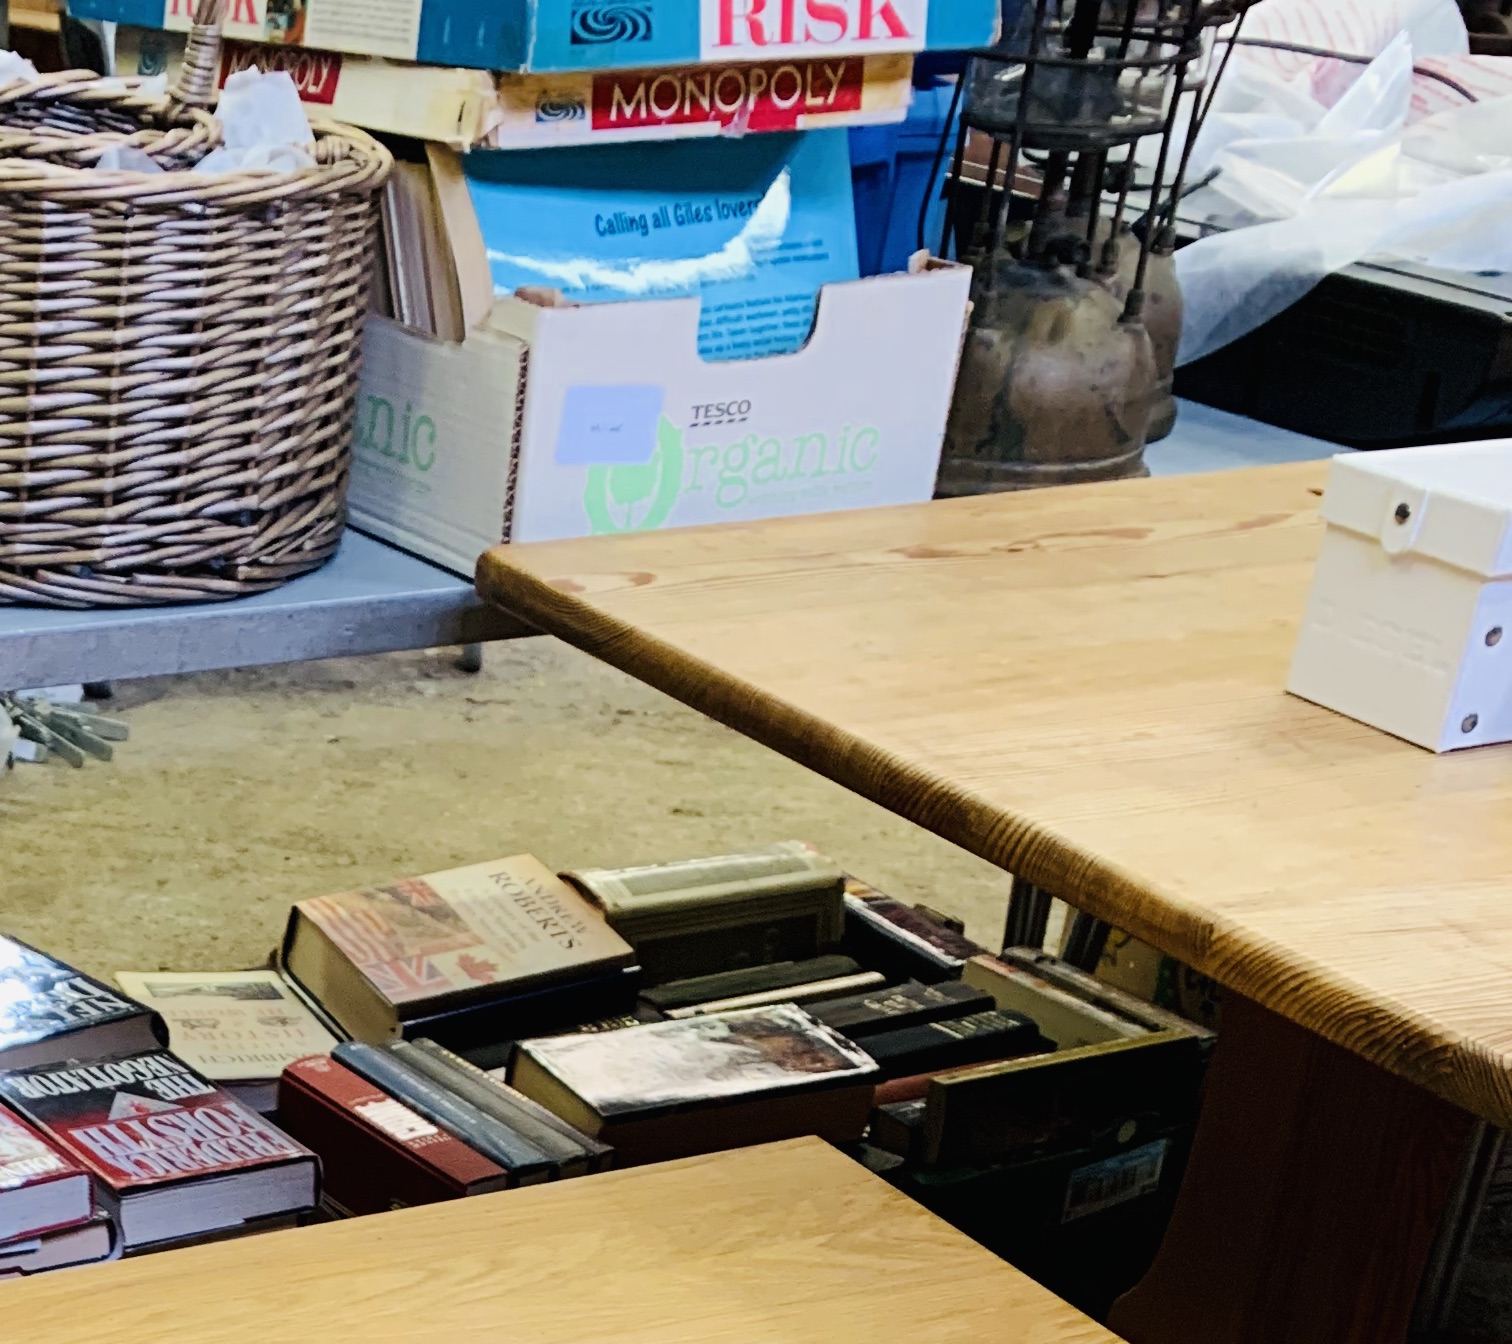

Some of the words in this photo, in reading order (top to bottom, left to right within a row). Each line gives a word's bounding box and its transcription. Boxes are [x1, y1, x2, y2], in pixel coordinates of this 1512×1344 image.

[712, 0, 917, 47] RISK
[609, 61, 847, 122] MONOPOLY
[594, 213, 649, 236] Calling
[652, 206, 671, 228] all
[673, 202, 713, 226] Giles
[691, 400, 752, 421] TESCO
[488, 871, 583, 950] ROBERTS
[11, 1053, 190, 1099] NEGOTIATOR
[143, 1072, 217, 1101] THE
[67, 1101, 278, 1157] FORSYTH
[103, 1127, 293, 1177] FREDERICK
